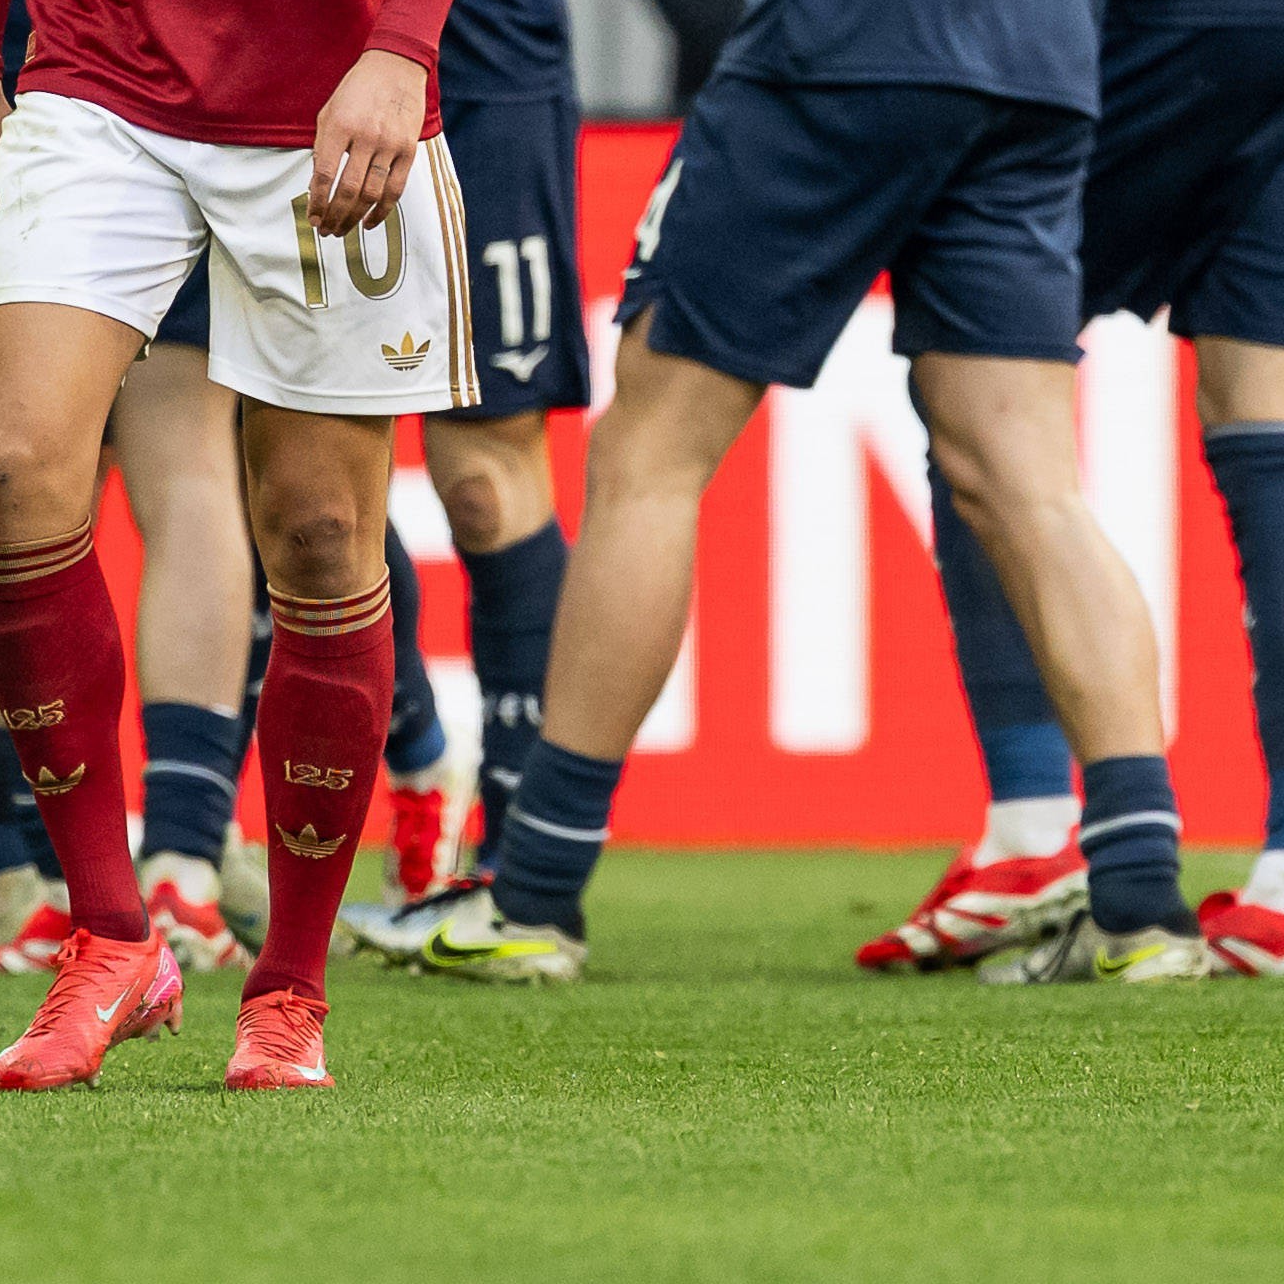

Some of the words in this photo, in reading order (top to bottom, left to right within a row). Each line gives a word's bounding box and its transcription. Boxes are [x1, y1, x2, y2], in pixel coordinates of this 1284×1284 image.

[291, 191, 407, 310] 10
[482, 234, 552, 348] 11
[2, 699, 66, 731] 125
[283, 759, 355, 791] 125
